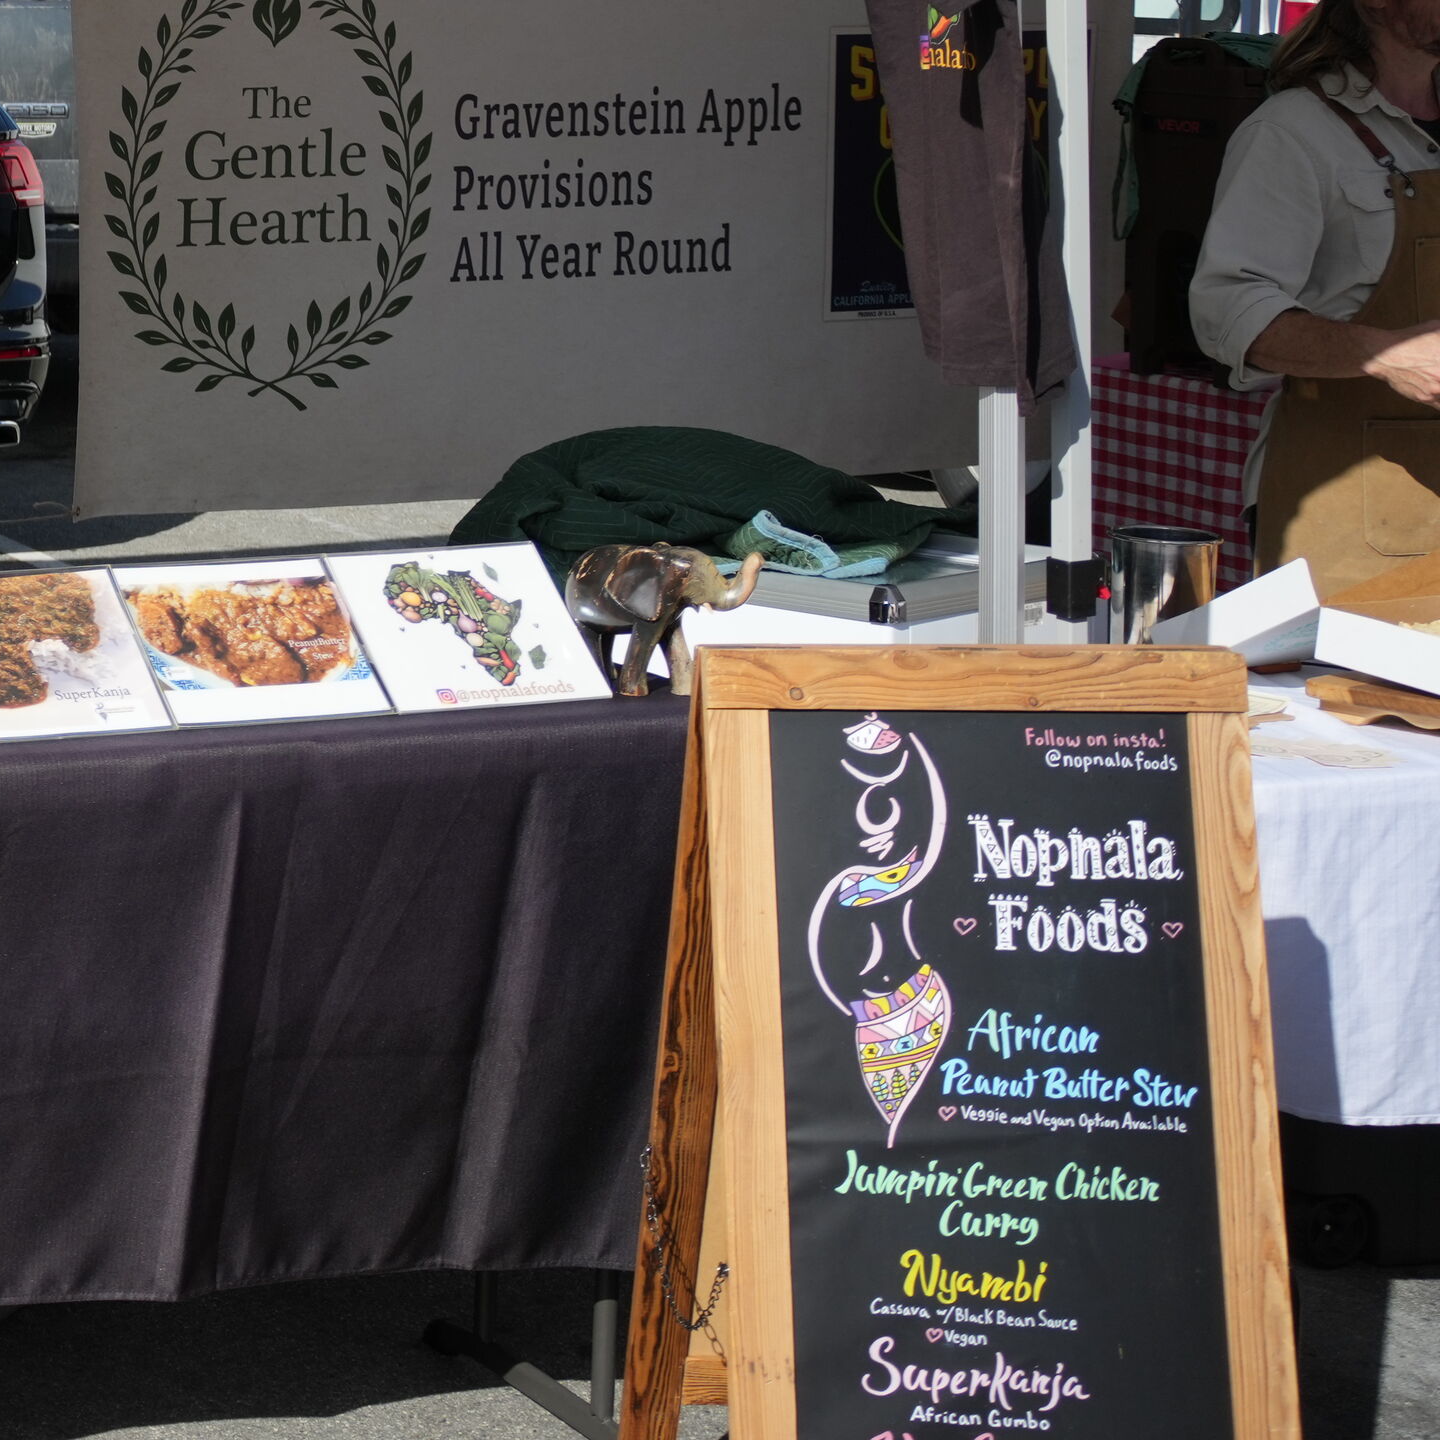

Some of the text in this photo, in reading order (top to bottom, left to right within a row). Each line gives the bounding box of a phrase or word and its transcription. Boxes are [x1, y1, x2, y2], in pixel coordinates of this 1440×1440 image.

[242, 86, 311, 120] The
[453, 82, 802, 147] Gravenstein Apple
[184, 127, 367, 182] Gentle
[452, 159, 654, 212] Provisions
[176, 193, 372, 248] Hearth
[450, 223, 732, 283] All Year Round
[54, 686, 131, 702] SuperKanja
[457, 679, 576, 704] @nopnalafoods
[1025, 728, 1167, 748] Follow on insta!
[967, 814, 1182, 886] Nopnala
[988, 894, 1147, 953] Foods
[967, 1008, 1100, 1059] African
[939, 1058, 1199, 1108] Peanut Butter Stew
[961, 1105, 1188, 1133] Veggie and Vegan Option Available
[962, 1161, 1048, 1202] Green
[1055, 1161, 1160, 1202] Chicken
[938, 1200, 1039, 1245] Curry
[900, 1248, 1048, 1304] Nyambi
[870, 1297, 930, 1319] Cassava
[996, 1310, 1036, 1327] Bean
[1038, 1309, 1078, 1331] Sauce
[944, 1329, 988, 1347] Vegan
[910, 1405, 1051, 1430] African Gumbo
